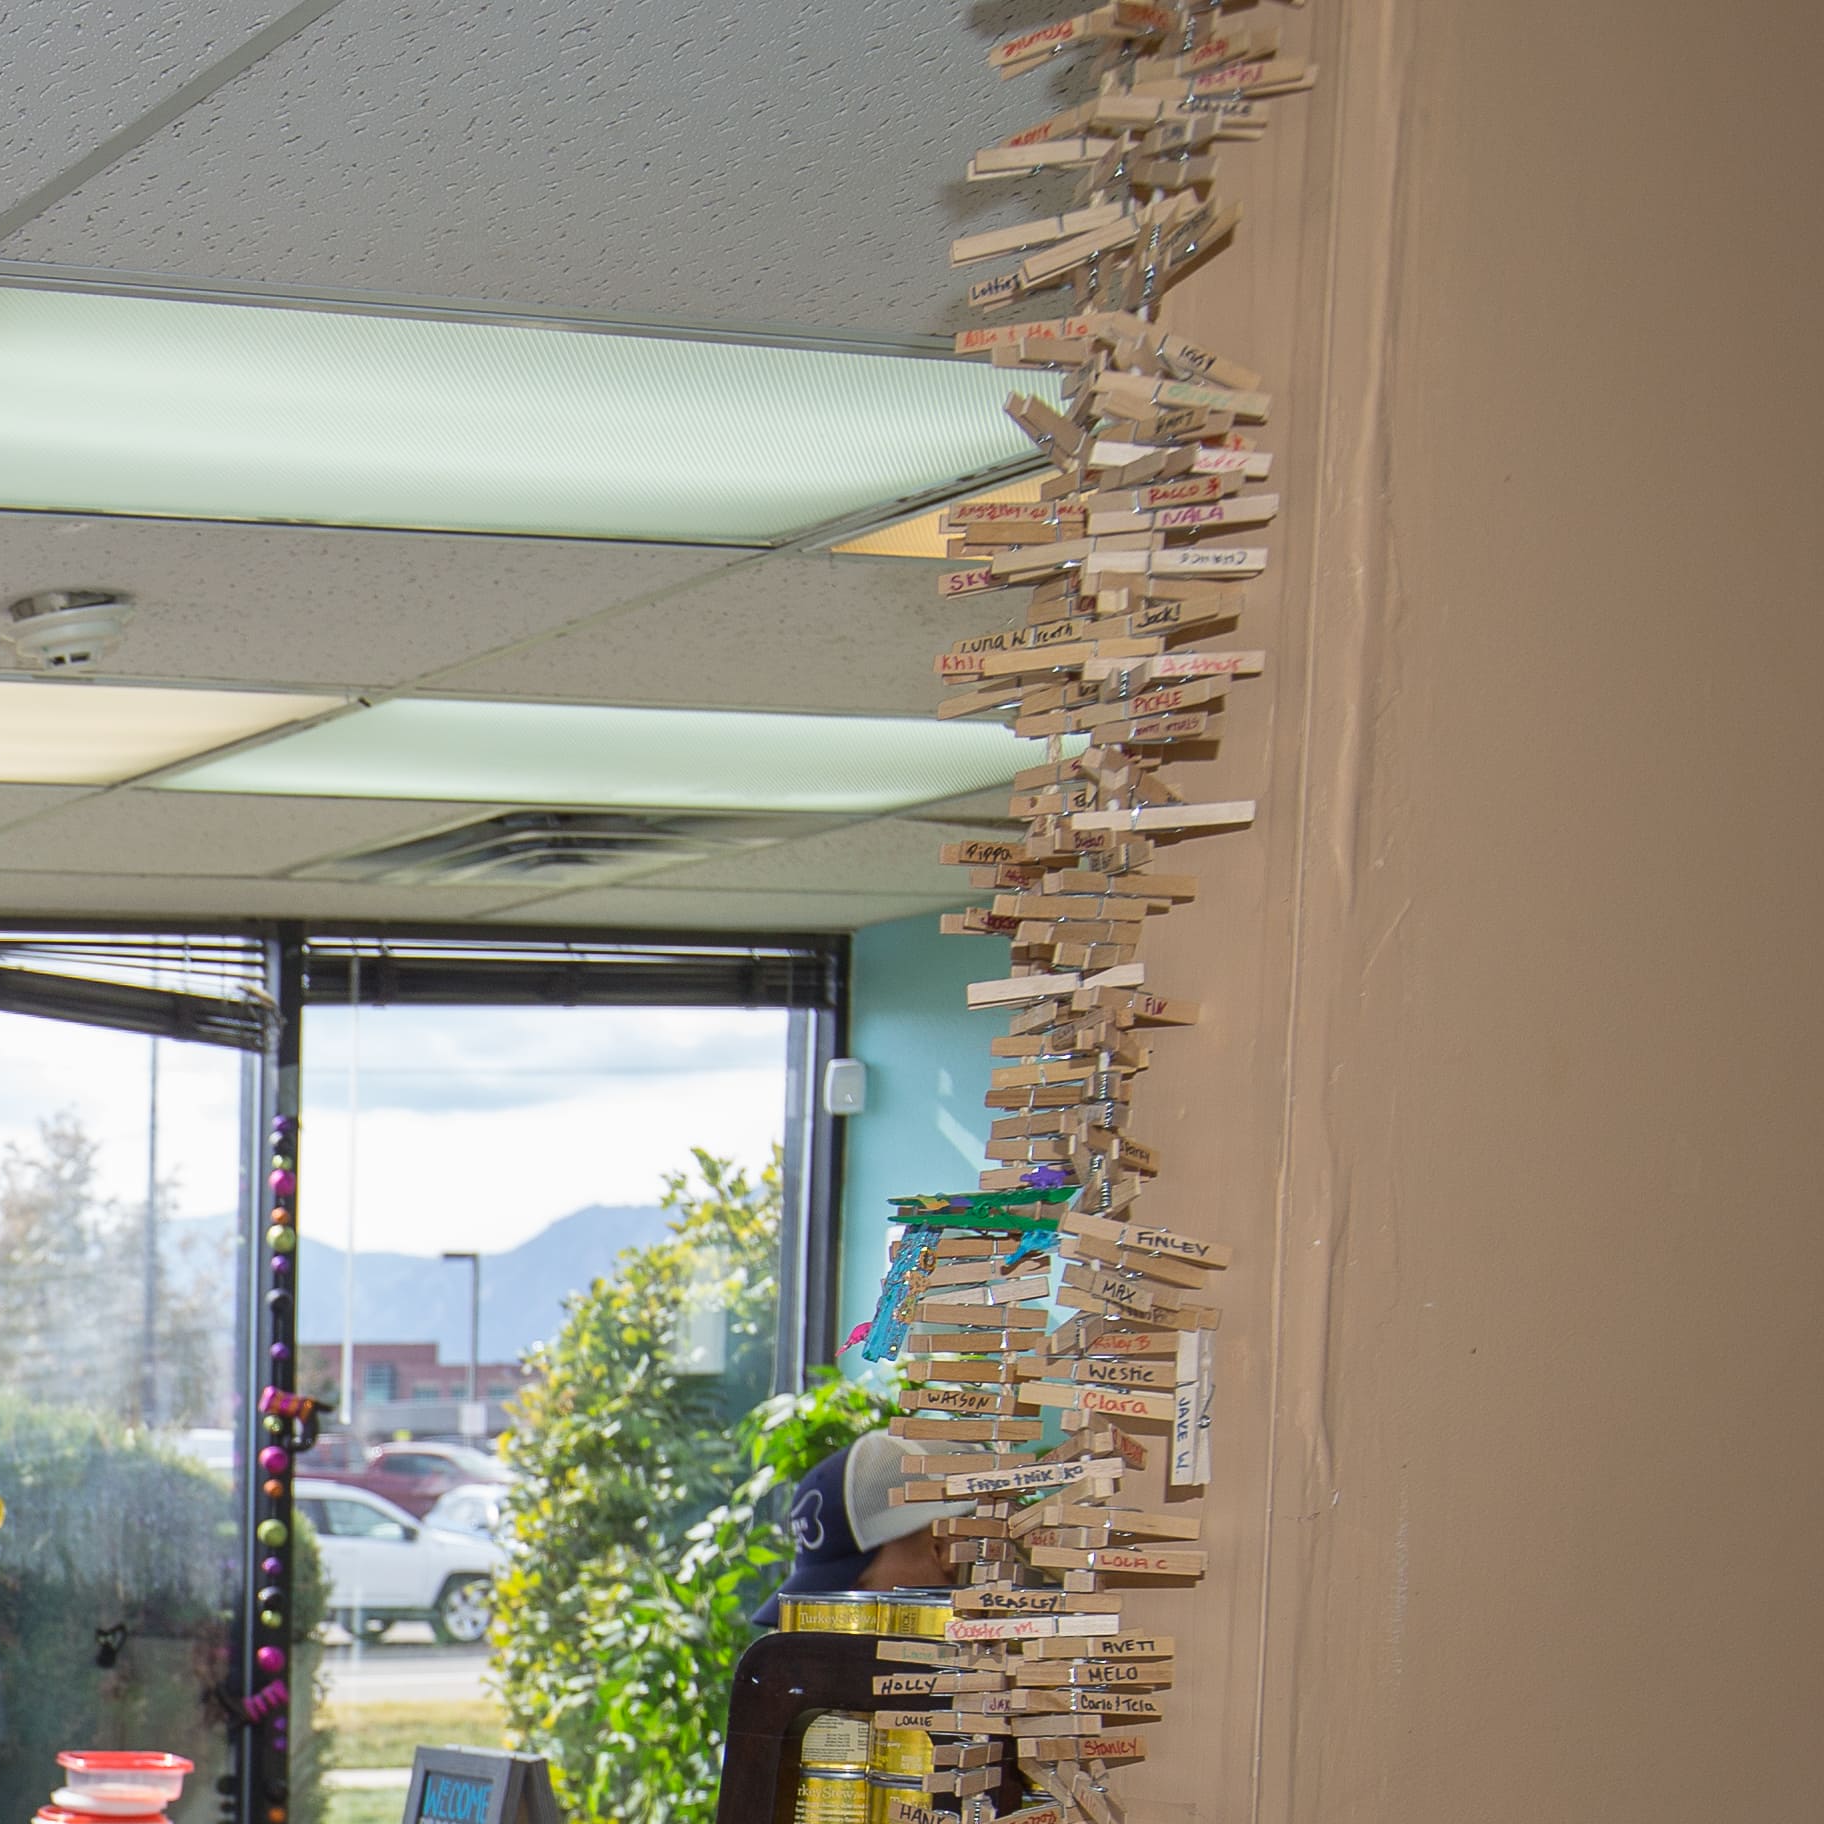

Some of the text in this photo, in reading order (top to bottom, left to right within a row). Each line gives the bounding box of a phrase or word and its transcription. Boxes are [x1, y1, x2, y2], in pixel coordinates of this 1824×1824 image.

[1162, 507, 1224, 525] NALA
[1133, 691, 1182, 713] PICKLE
[1137, 1231, 1210, 1257] FINLEY
[927, 1393, 990, 1409] WATSON
[1083, 1391, 1148, 1415] Clara
[1176, 1397, 1192, 1441] JAKE
[979, 1593, 1059, 1612] BEASLEY
[1089, 1667, 1138, 1682] MELO
[881, 1677, 939, 1695] HOLLY
